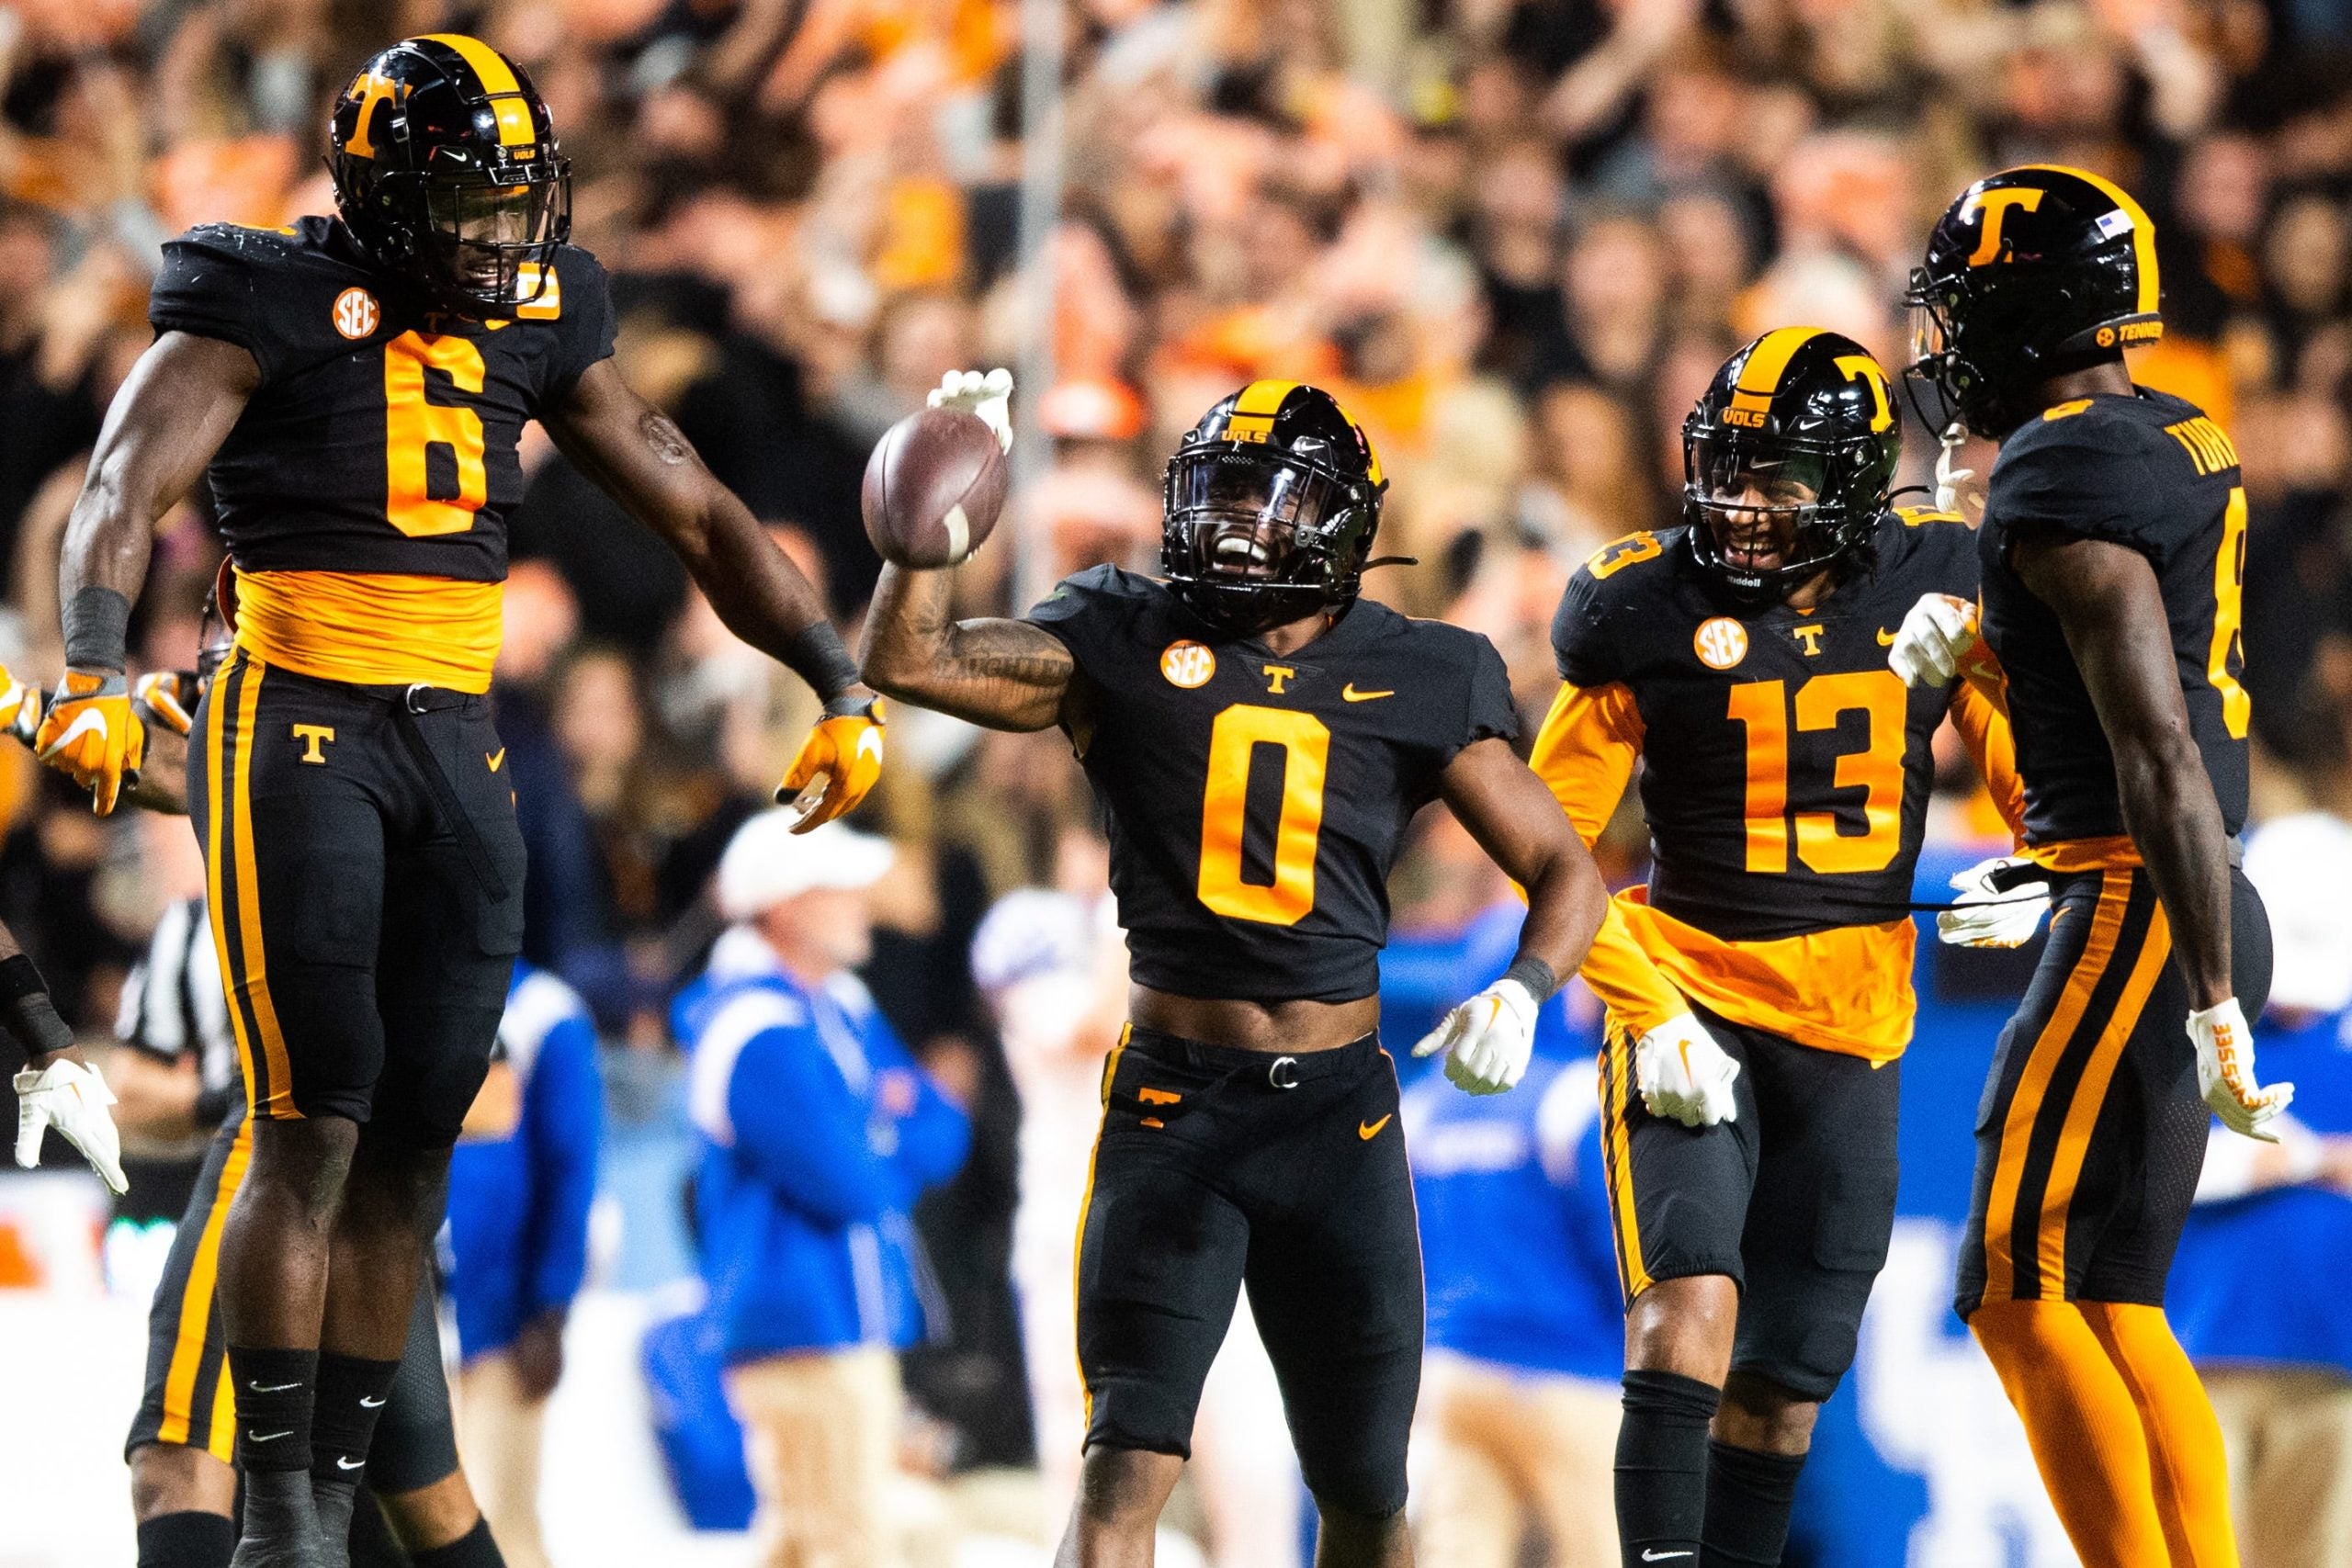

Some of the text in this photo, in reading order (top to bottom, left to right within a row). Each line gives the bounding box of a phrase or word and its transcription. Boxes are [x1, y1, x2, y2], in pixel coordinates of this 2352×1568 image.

[345, 73, 413, 160] T
[514, 149, 536, 160] VOLS
[1958, 186, 2044, 268] T
[337, 290, 378, 337] SEC
[1832, 355, 1894, 432] T
[385, 329, 487, 537] 6
[1221, 430, 1268, 444] VOLS
[1723, 409, 1765, 429] VOLS
[1698, 618, 1747, 667] SEC
[1792, 624, 1824, 657] T
[1165, 645, 1211, 685] SEC
[1262, 664, 1295, 694] T
[292, 723, 335, 763] T
[1726, 670, 1907, 874] 13
[1196, 703, 1331, 927] 0
